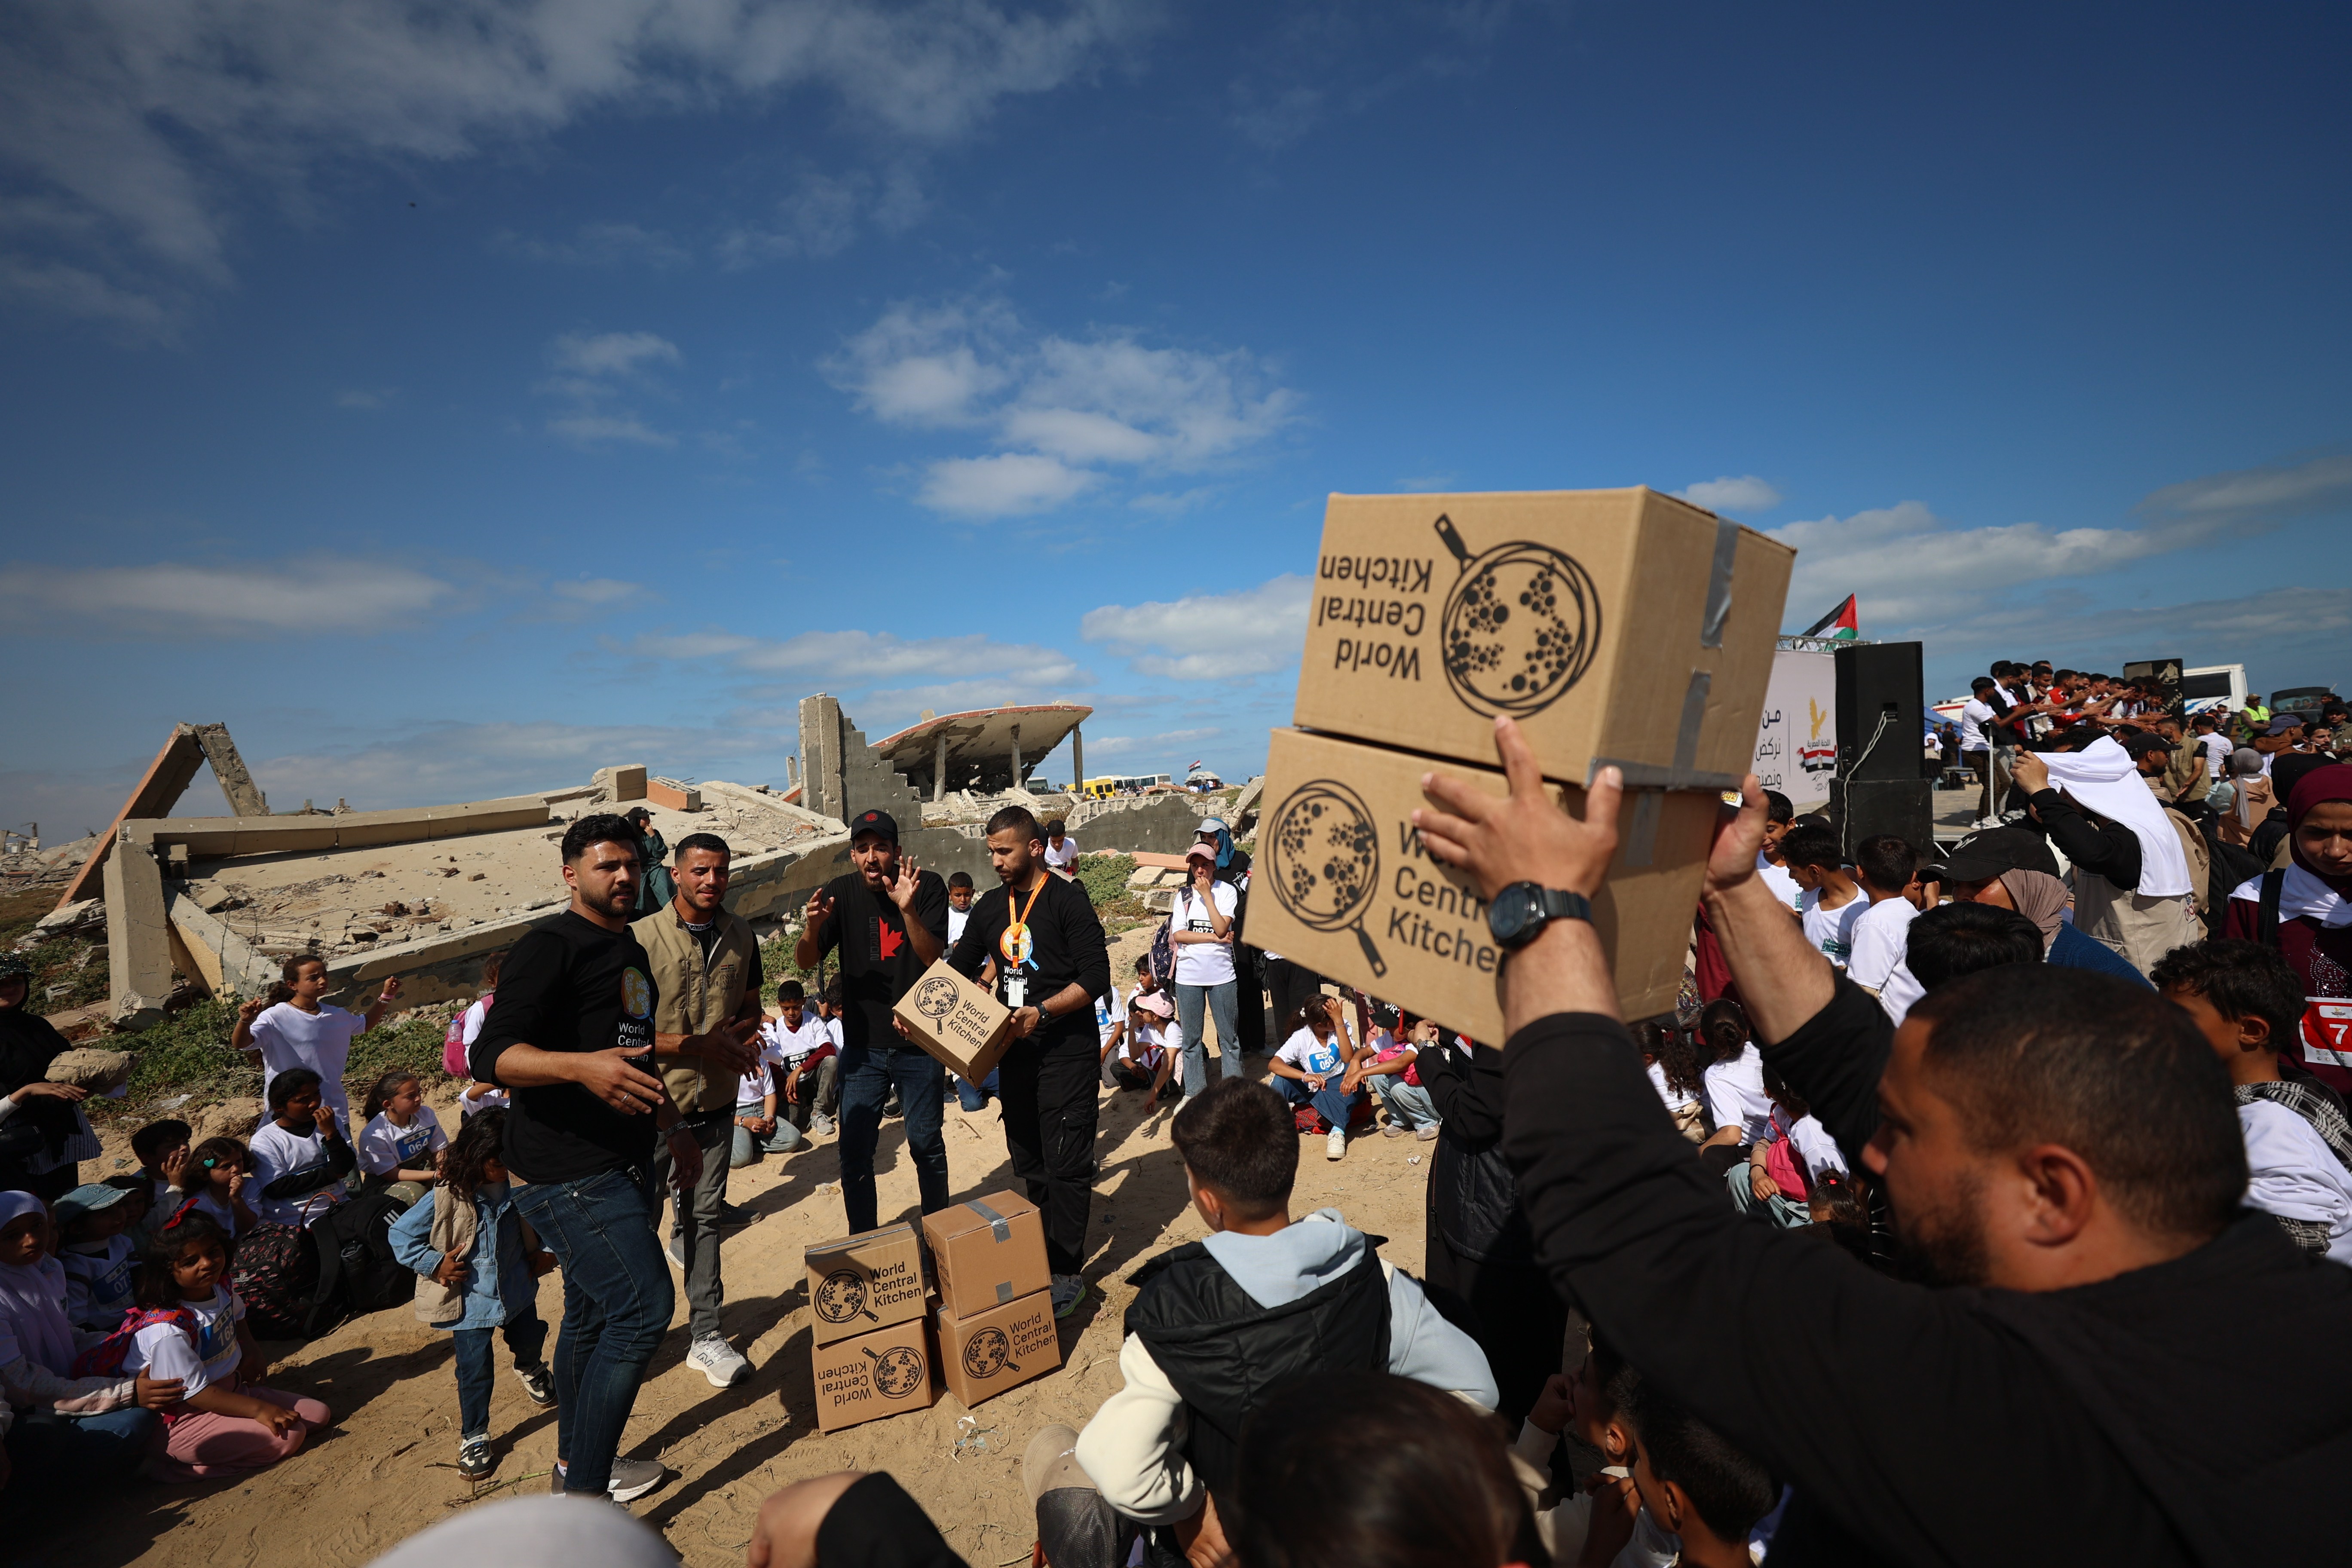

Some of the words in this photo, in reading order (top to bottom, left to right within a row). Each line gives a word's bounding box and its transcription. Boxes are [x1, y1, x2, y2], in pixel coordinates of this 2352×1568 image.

[1321, 555, 1434, 593] Kitchen
[1318, 596, 1426, 636] Central
[1335, 638, 1421, 681] World
[1763, 710, 1781, 729] من
[1756, 737, 1780, 761] نركض
[1396, 867, 1488, 922] Centr
[963, 999, 990, 1024] World
[619, 1022, 645, 1035] World
[947, 1018, 982, 1049] Kitchen
[955, 1010, 990, 1038] Central
[1320, 1055, 1335, 1070] 050
[869, 1261, 905, 1280] World
[873, 1272, 917, 1294] Central
[874, 1288, 922, 1308] Kitchen
[1009, 1312, 1041, 1334] World
[1013, 1320, 1051, 1346] Central
[1015, 1334, 1056, 1359] Kitchen
[818, 1361, 867, 1380] Kitchen
[822, 1375, 868, 1396] Central
[834, 1387, 872, 1407] World
